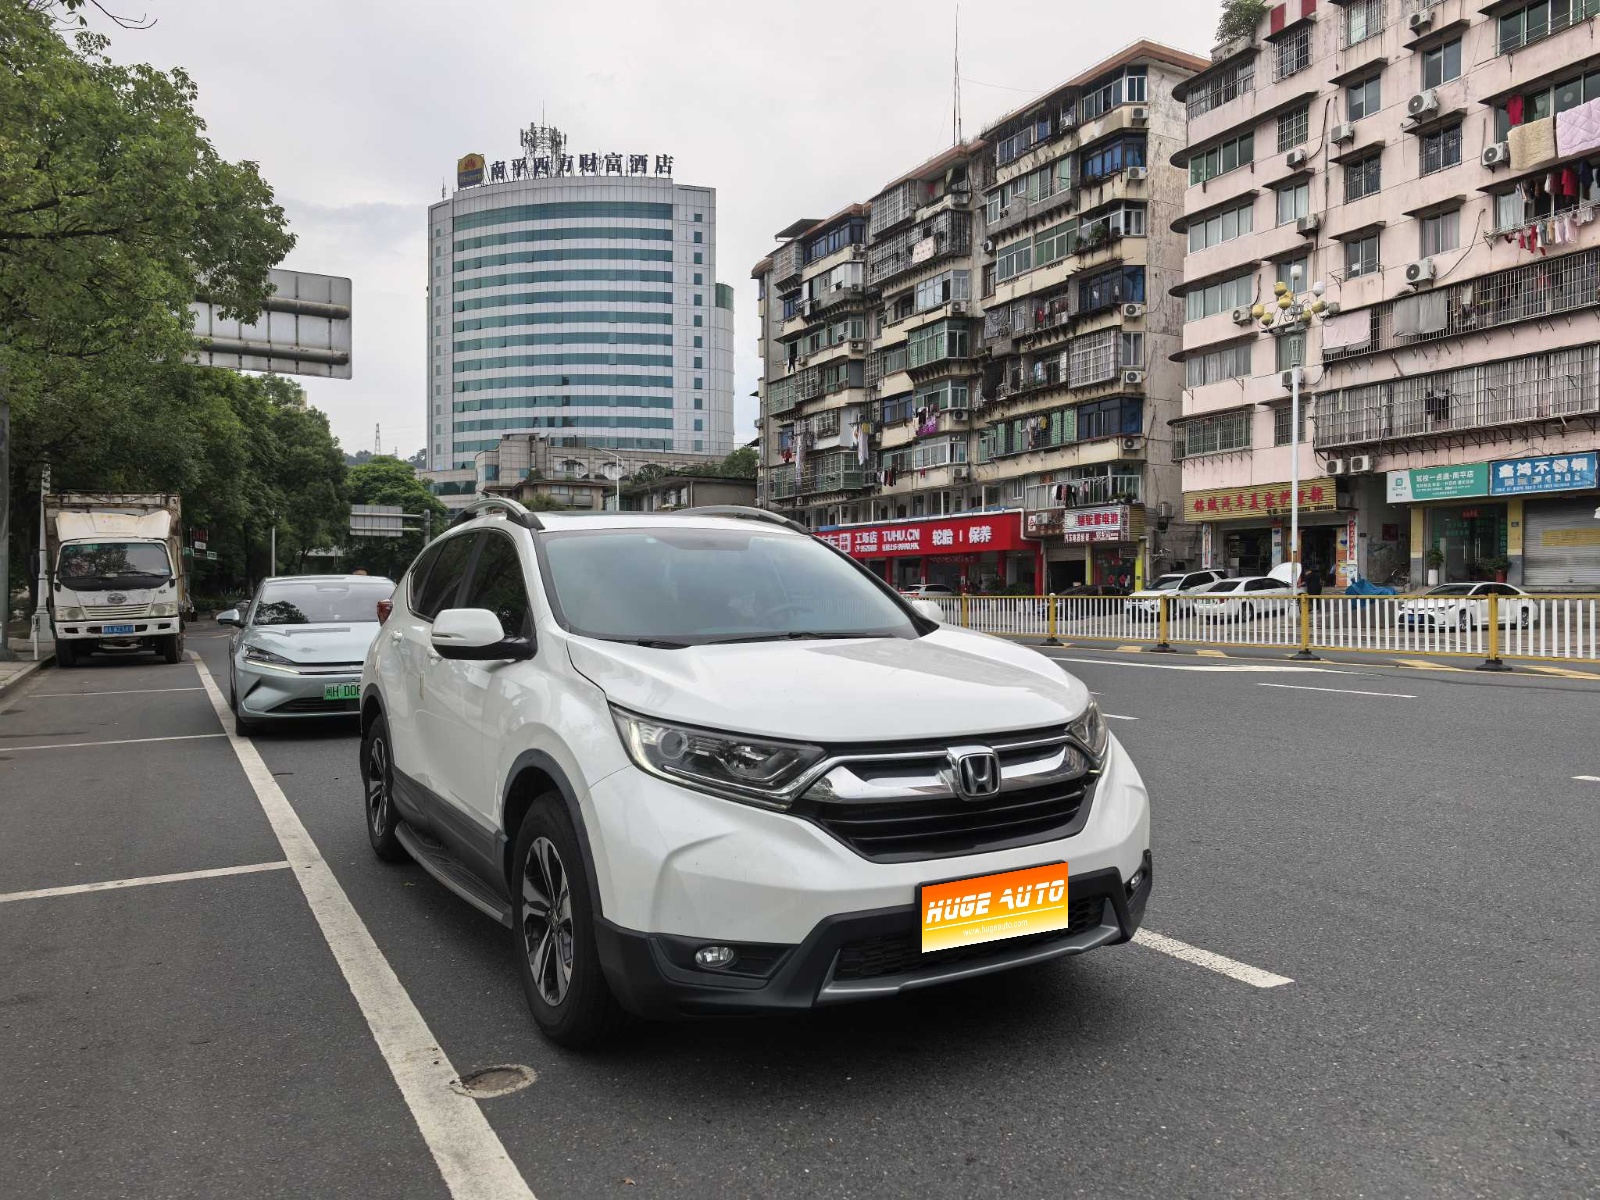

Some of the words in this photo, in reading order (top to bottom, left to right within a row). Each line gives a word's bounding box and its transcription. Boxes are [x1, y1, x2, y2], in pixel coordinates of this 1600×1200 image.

[882, 528, 920, 542] TUHU.CN
[932, 529, 953, 546] 轮胎
[969, 525, 992, 544] 保养
